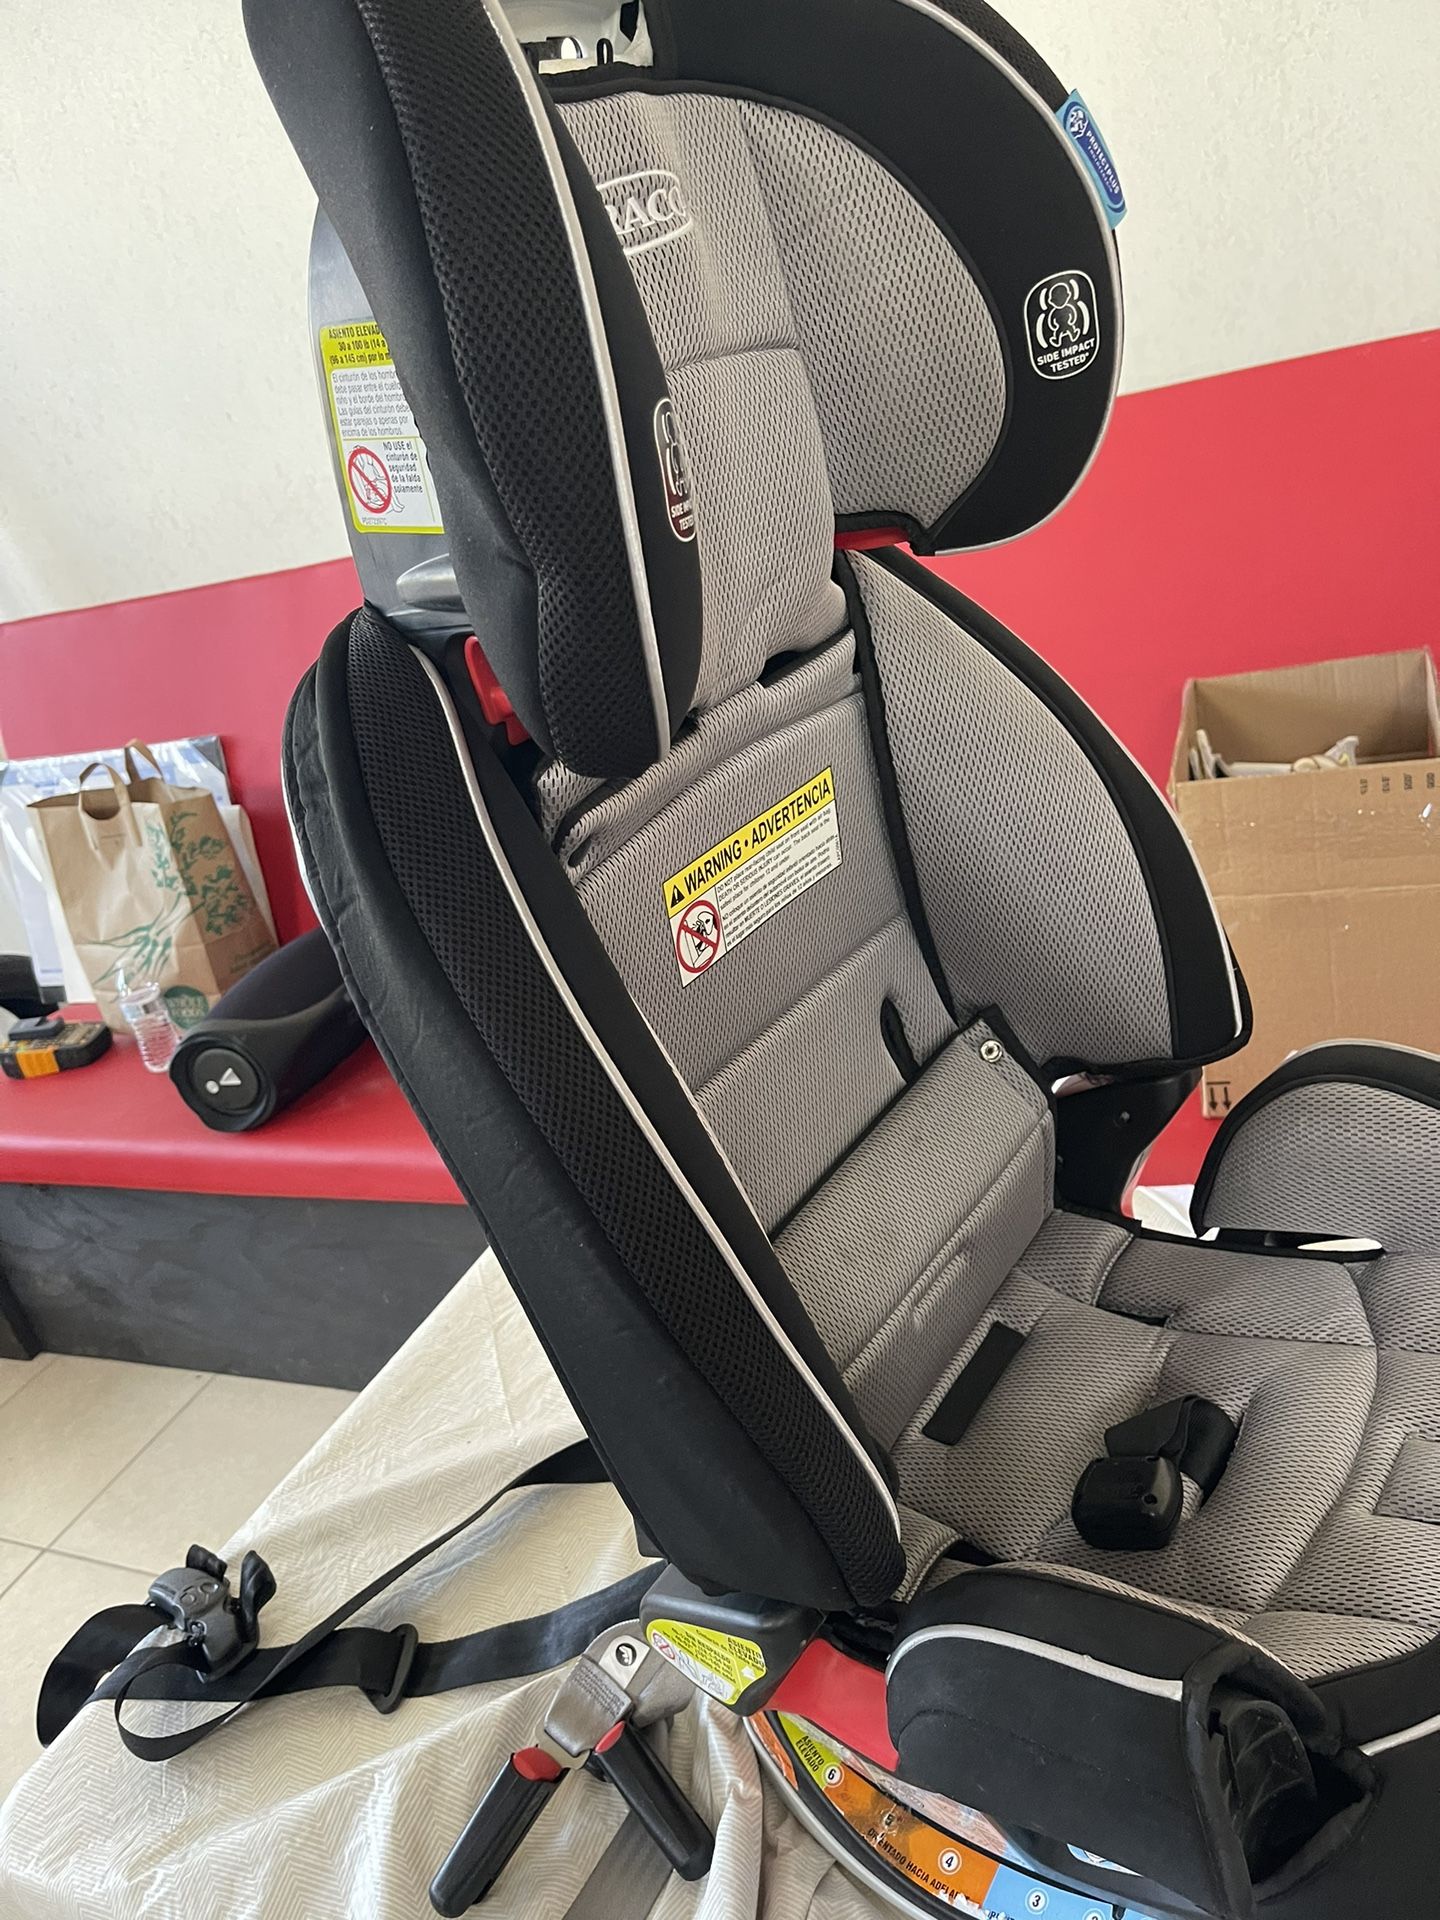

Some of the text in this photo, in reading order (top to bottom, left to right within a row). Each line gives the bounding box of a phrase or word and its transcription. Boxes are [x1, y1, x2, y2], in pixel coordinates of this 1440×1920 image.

[1086, 130, 1120, 193] PROTECTPLUS
[605, 186, 686, 235] RACO
[328, 324, 381, 339] ASIENTO ELEVAD
[1037, 337, 1095, 366] SIDE IMPACT
[377, 369, 397, 380] hombr
[395, 402, 411, 413] debe
[383, 441, 392, 451] NO
[392, 440, 406, 451] USE
[684, 839, 742, 896] WARNING
[751, 777, 831, 849] ADVERTENCIA
[795, 1739, 820, 1773] ELEVADO
[801, 1735, 825, 1766] ASIENTO
[827, 1768, 837, 1780] 6
[905, 1860, 929, 1883] HACIA
[945, 1856, 954, 1868] 4
[1032, 1894, 1041, 1908] 3
